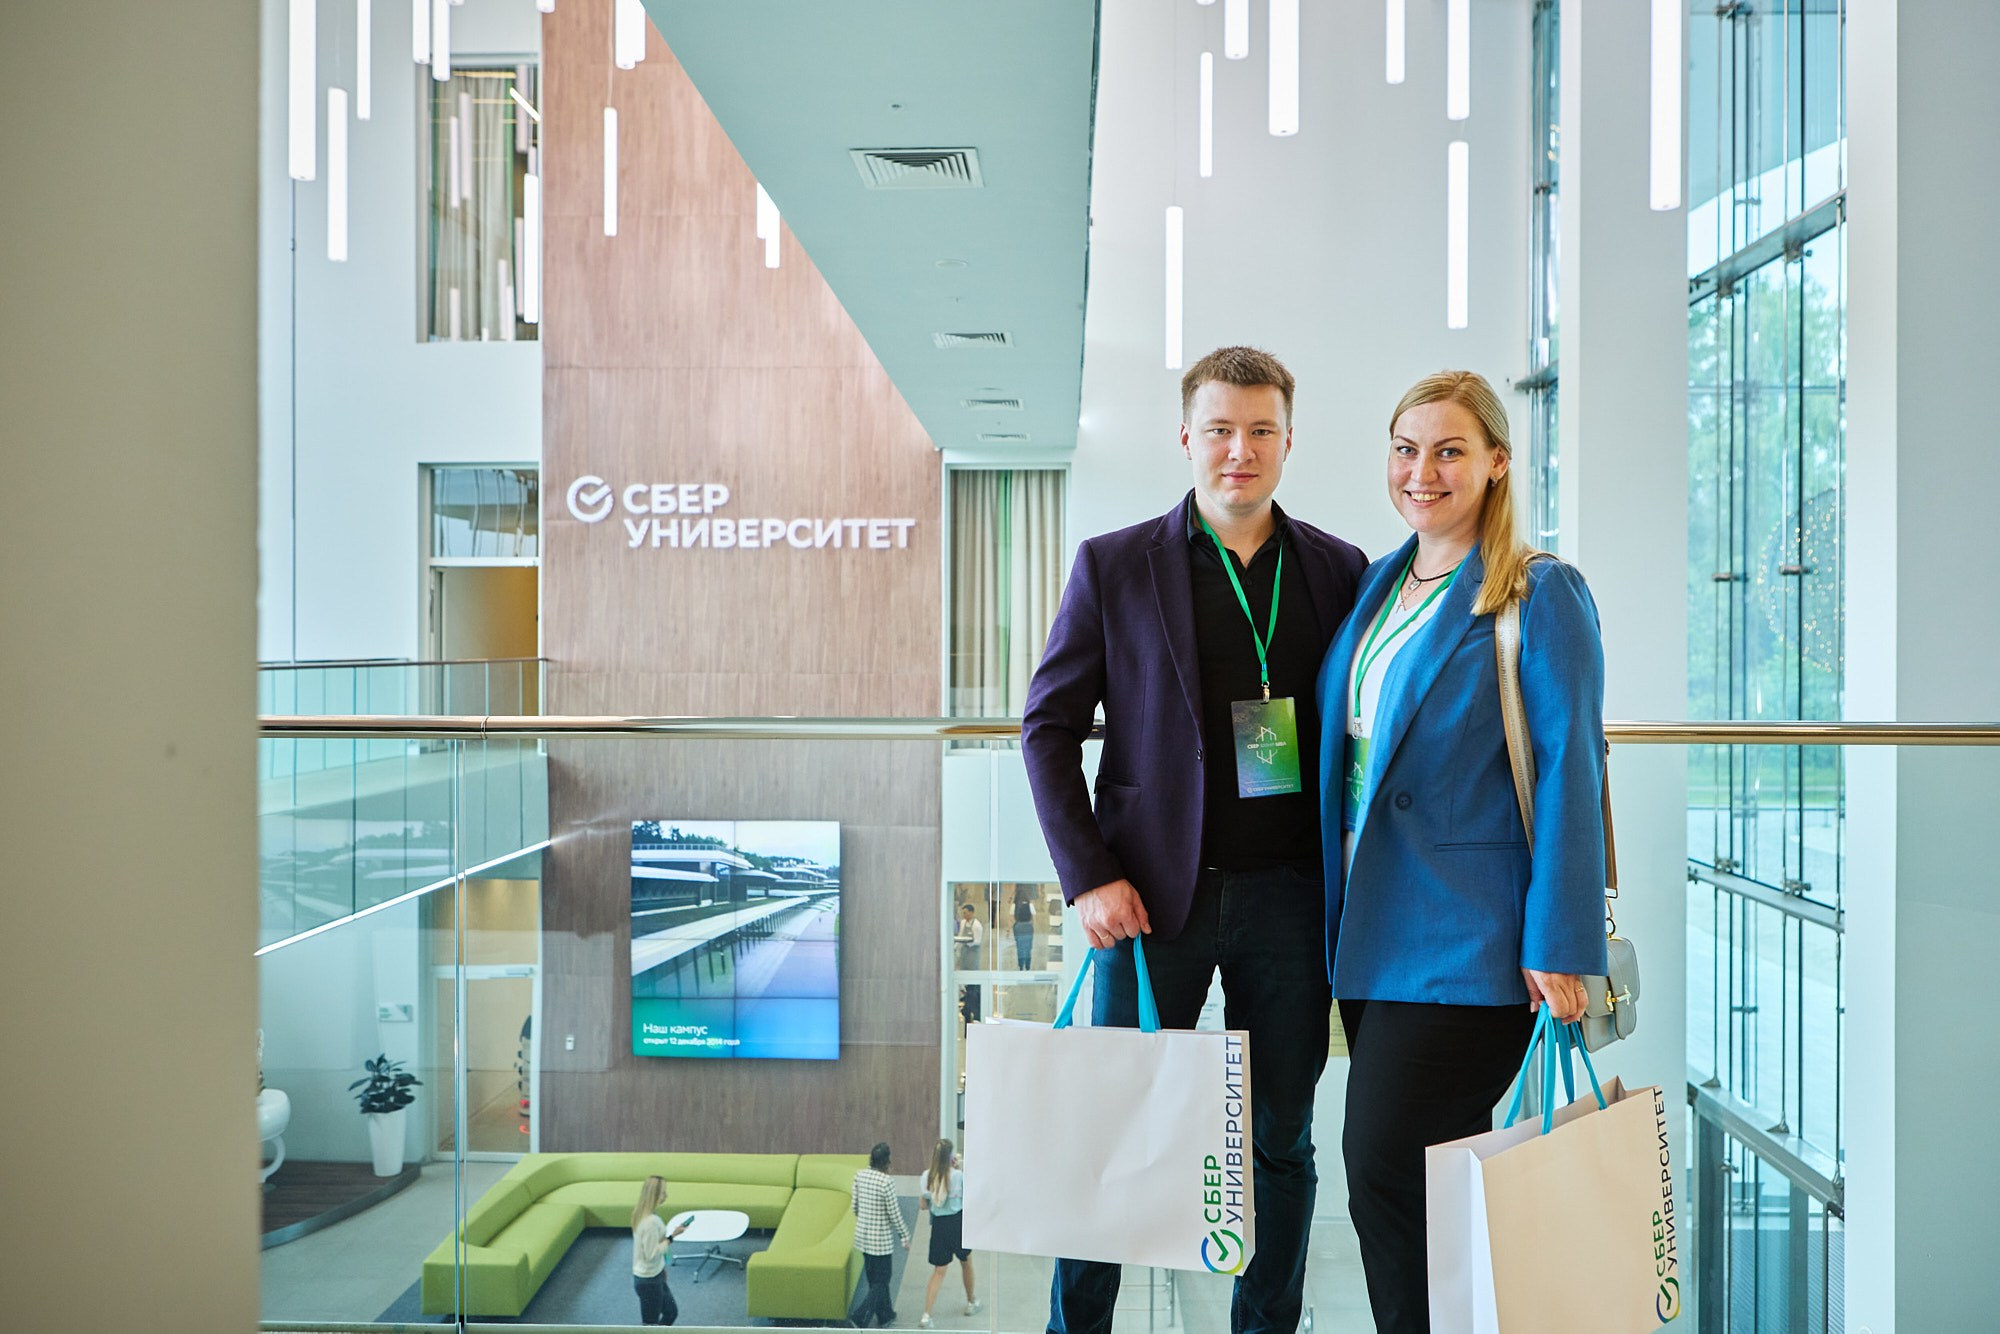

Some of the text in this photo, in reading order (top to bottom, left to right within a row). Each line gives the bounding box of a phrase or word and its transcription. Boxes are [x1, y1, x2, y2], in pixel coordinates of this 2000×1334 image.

[622, 483, 730, 514] СБЕР
[623, 518, 915, 549] УНИВЕРСИТЕТ
[643, 1023, 708, 1036] Наш кампус
[643, 1037, 668, 1045] открыт
[669, 1037, 677, 1045] 12
[677, 1037, 706, 1046] декабря
[1226, 1036, 1243, 1225] УНИВЕРСИТЕТ
[1204, 1154, 1222, 1224] СБЕР
[1653, 1087, 1678, 1272] УНИВЕРСИТЕТ
[1652, 1210, 1666, 1277] СБЕР
